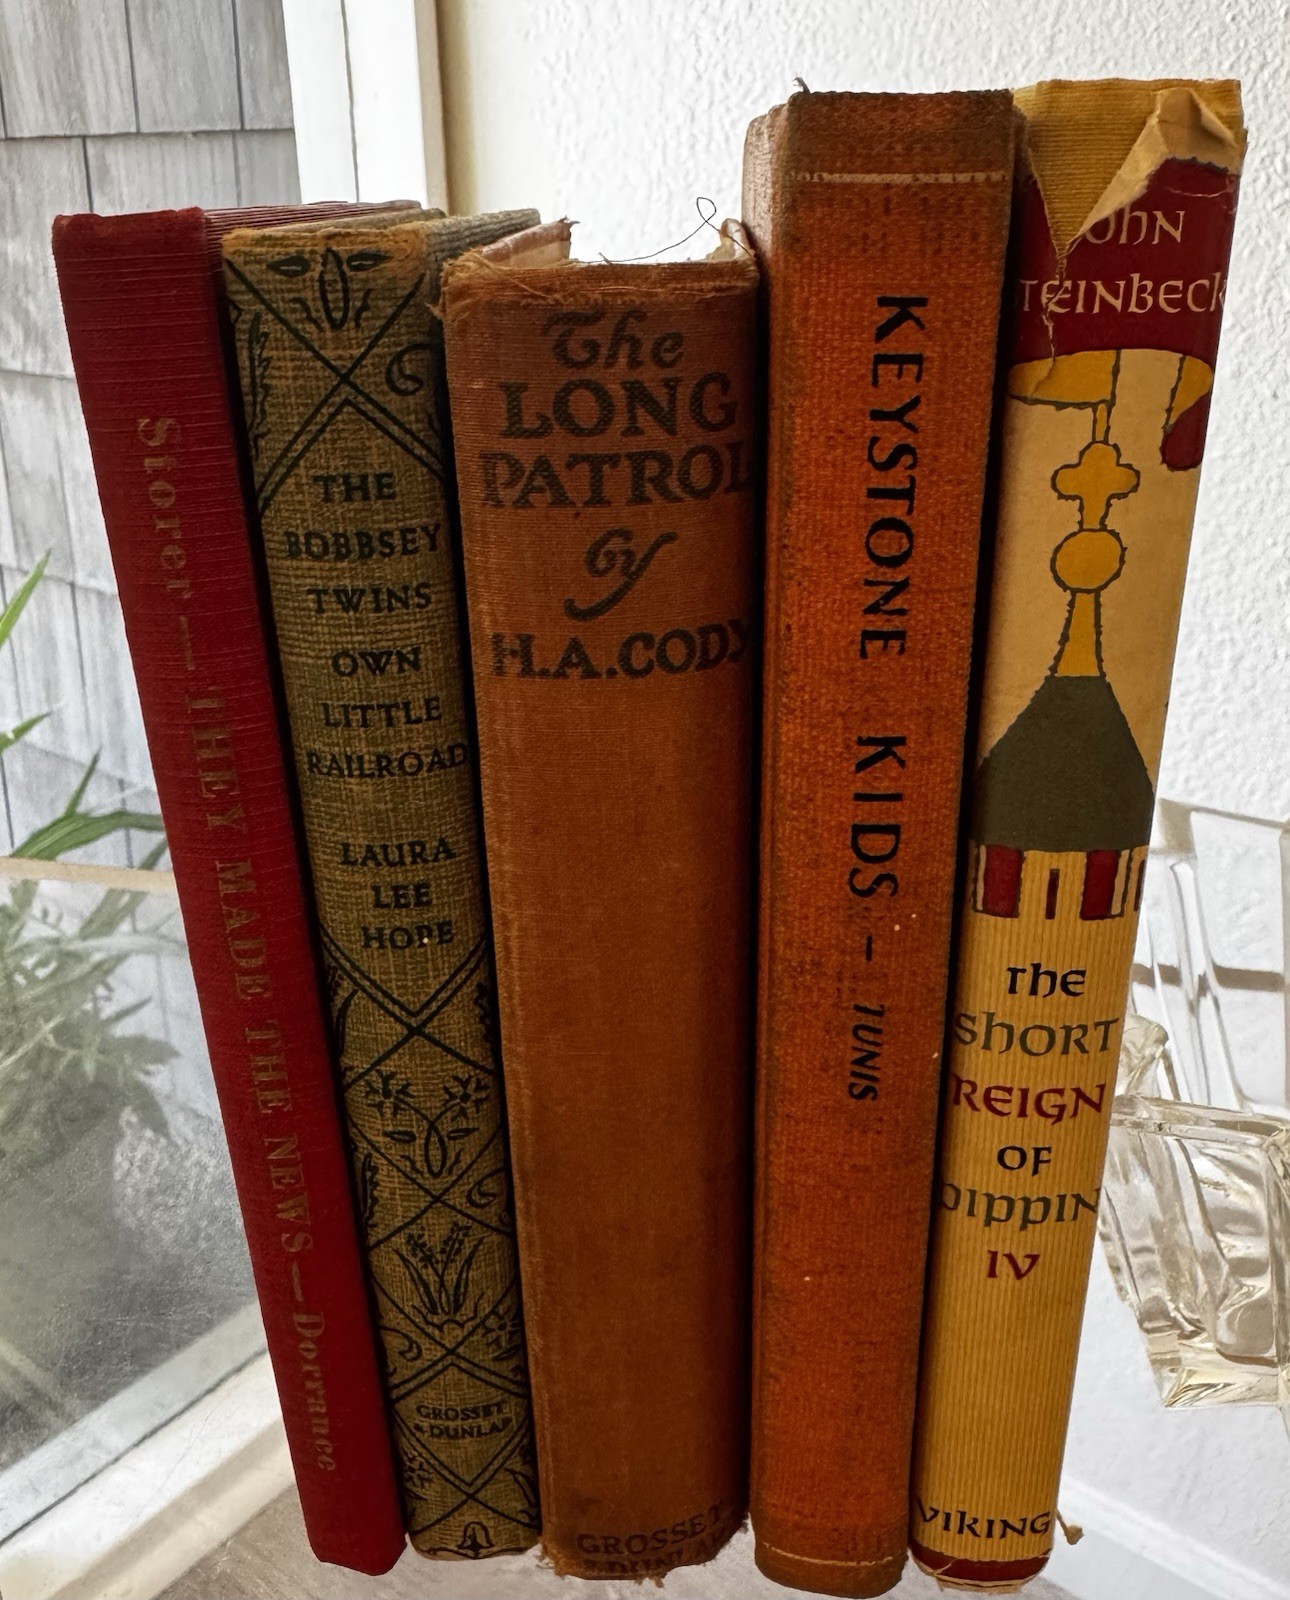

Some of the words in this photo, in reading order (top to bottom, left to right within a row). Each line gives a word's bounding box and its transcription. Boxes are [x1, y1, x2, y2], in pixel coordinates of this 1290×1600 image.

[1084, 203, 1186, 246] OHN
[1019, 271, 1227, 315] TEINBECK
[541, 308, 685, 370] The
[499, 372, 736, 440] LONG
[311, 471, 398, 502] THE
[477, 440, 753, 509] PATROL
[858, 295, 929, 660] KEYSTONE
[137, 416, 196, 600] Storer
[283, 522, 443, 560] BOBBSEY
[306, 581, 434, 615] TWINS
[563, 527, 678, 622] By
[331, 646, 422, 677] OWN
[321, 695, 443, 728] LITTLE
[187, 686, 249, 837] THEY
[306, 742, 470, 779] RAILROAD
[848, 735, 907, 898] KIDS
[340, 837, 457, 867] LAURA
[372, 882, 433, 910] LEE
[214, 859, 271, 1003] MADE
[361, 919, 455, 951] HOPE
[244, 1018, 293, 1115] THE
[952, 1072, 1107, 1126] REIGN
[996, 1145, 1053, 1177] OF
[263, 1134, 314, 1252] NEWS
[986, 1249, 1041, 1281] IV
[292, 1311, 337, 1472] Dorrance
